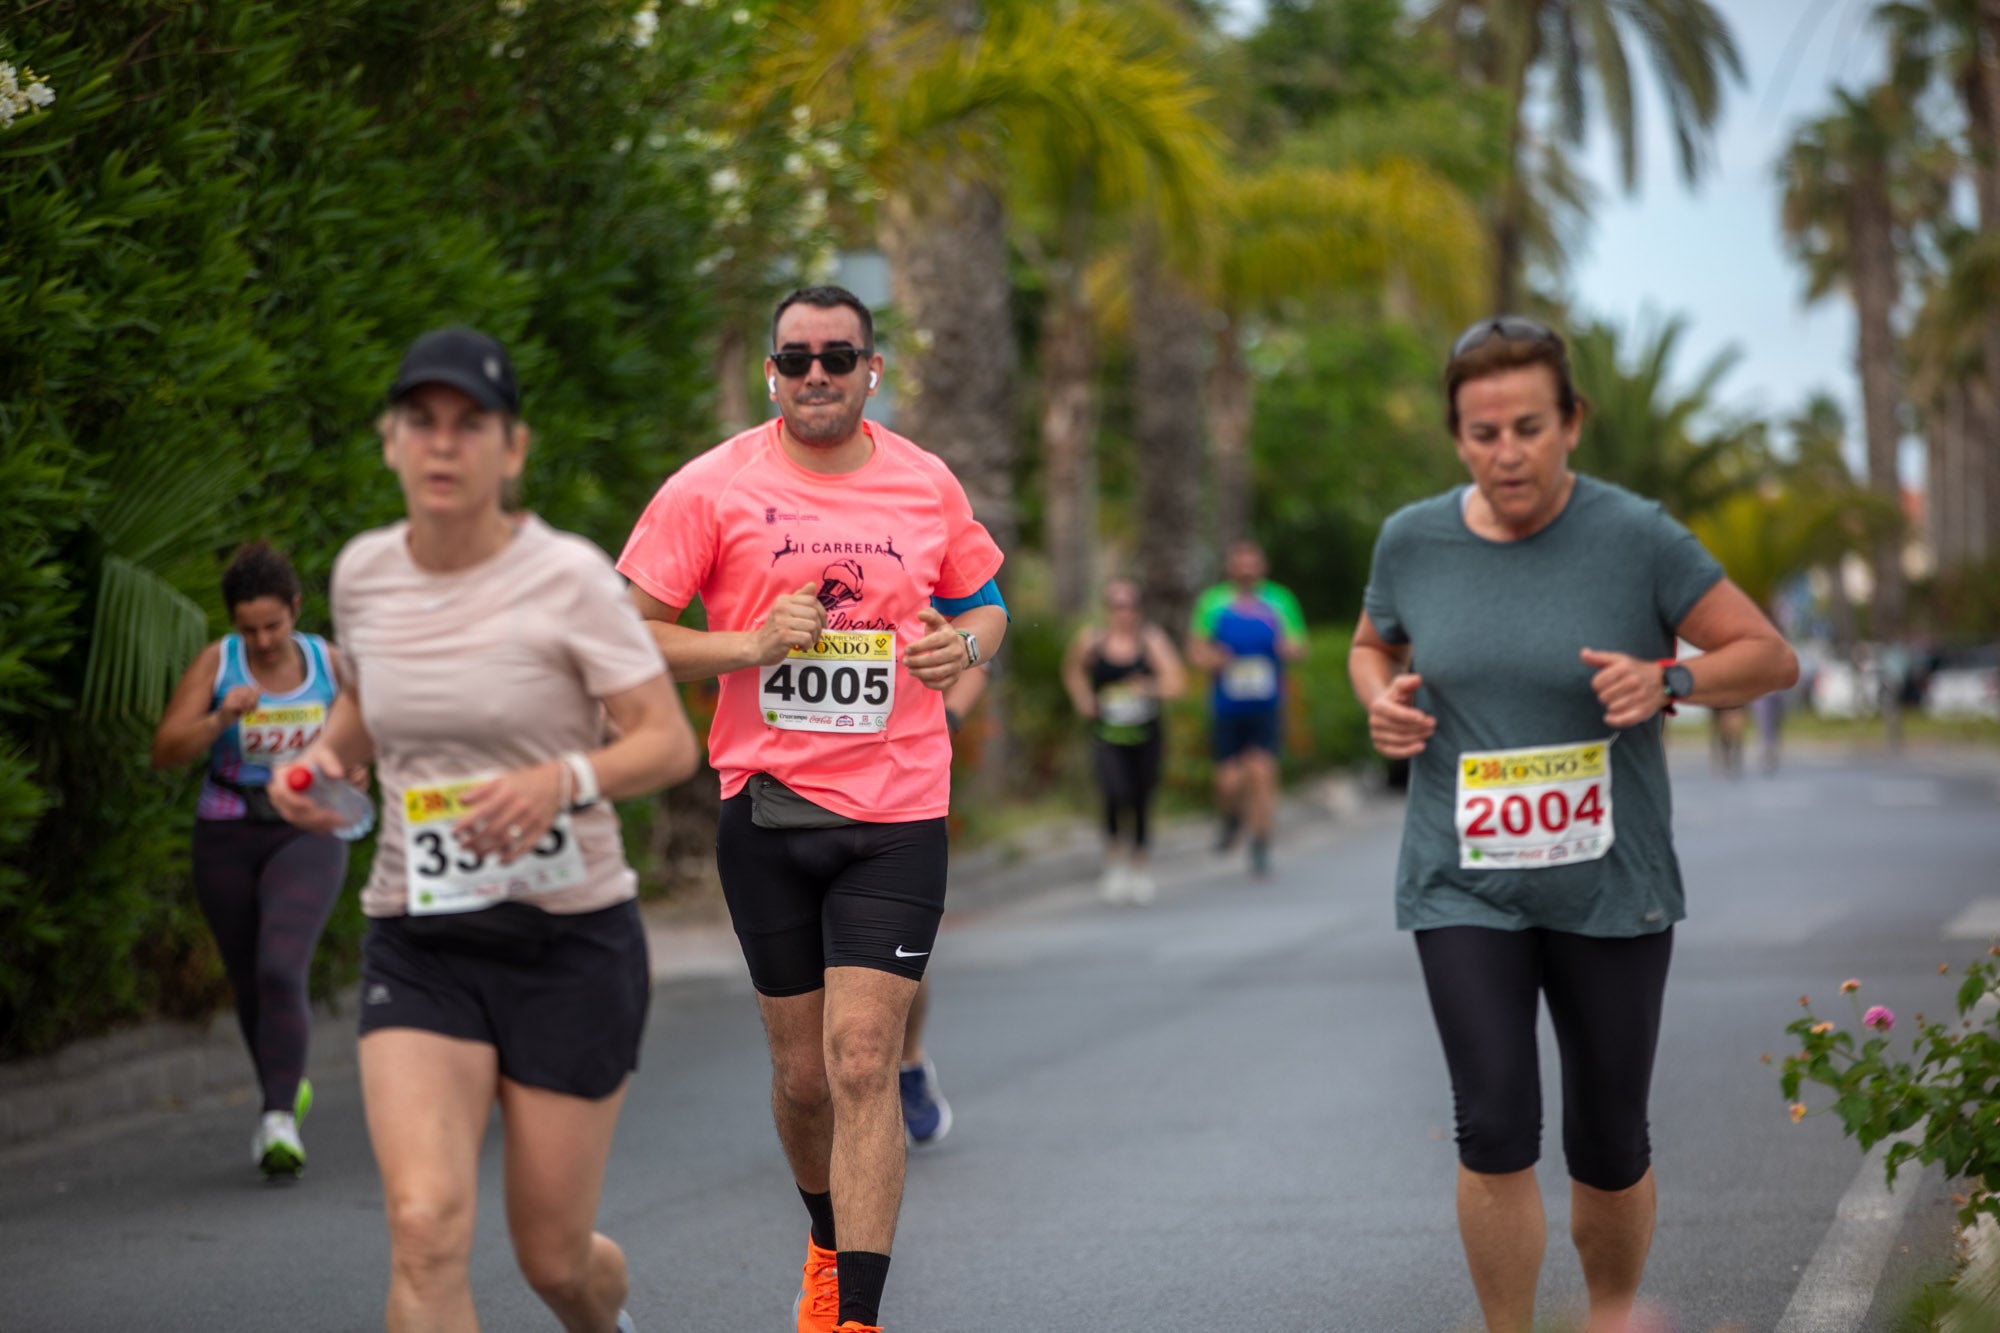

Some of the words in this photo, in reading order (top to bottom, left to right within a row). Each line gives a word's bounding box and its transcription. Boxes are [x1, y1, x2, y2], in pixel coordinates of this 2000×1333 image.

[812, 543, 884, 554] CARRERA
[803, 641, 870, 655] ONDO
[764, 664, 889, 706] 4005
[779, 713, 808, 721] Cruzcampo
[1465, 783, 1605, 838] 2004
